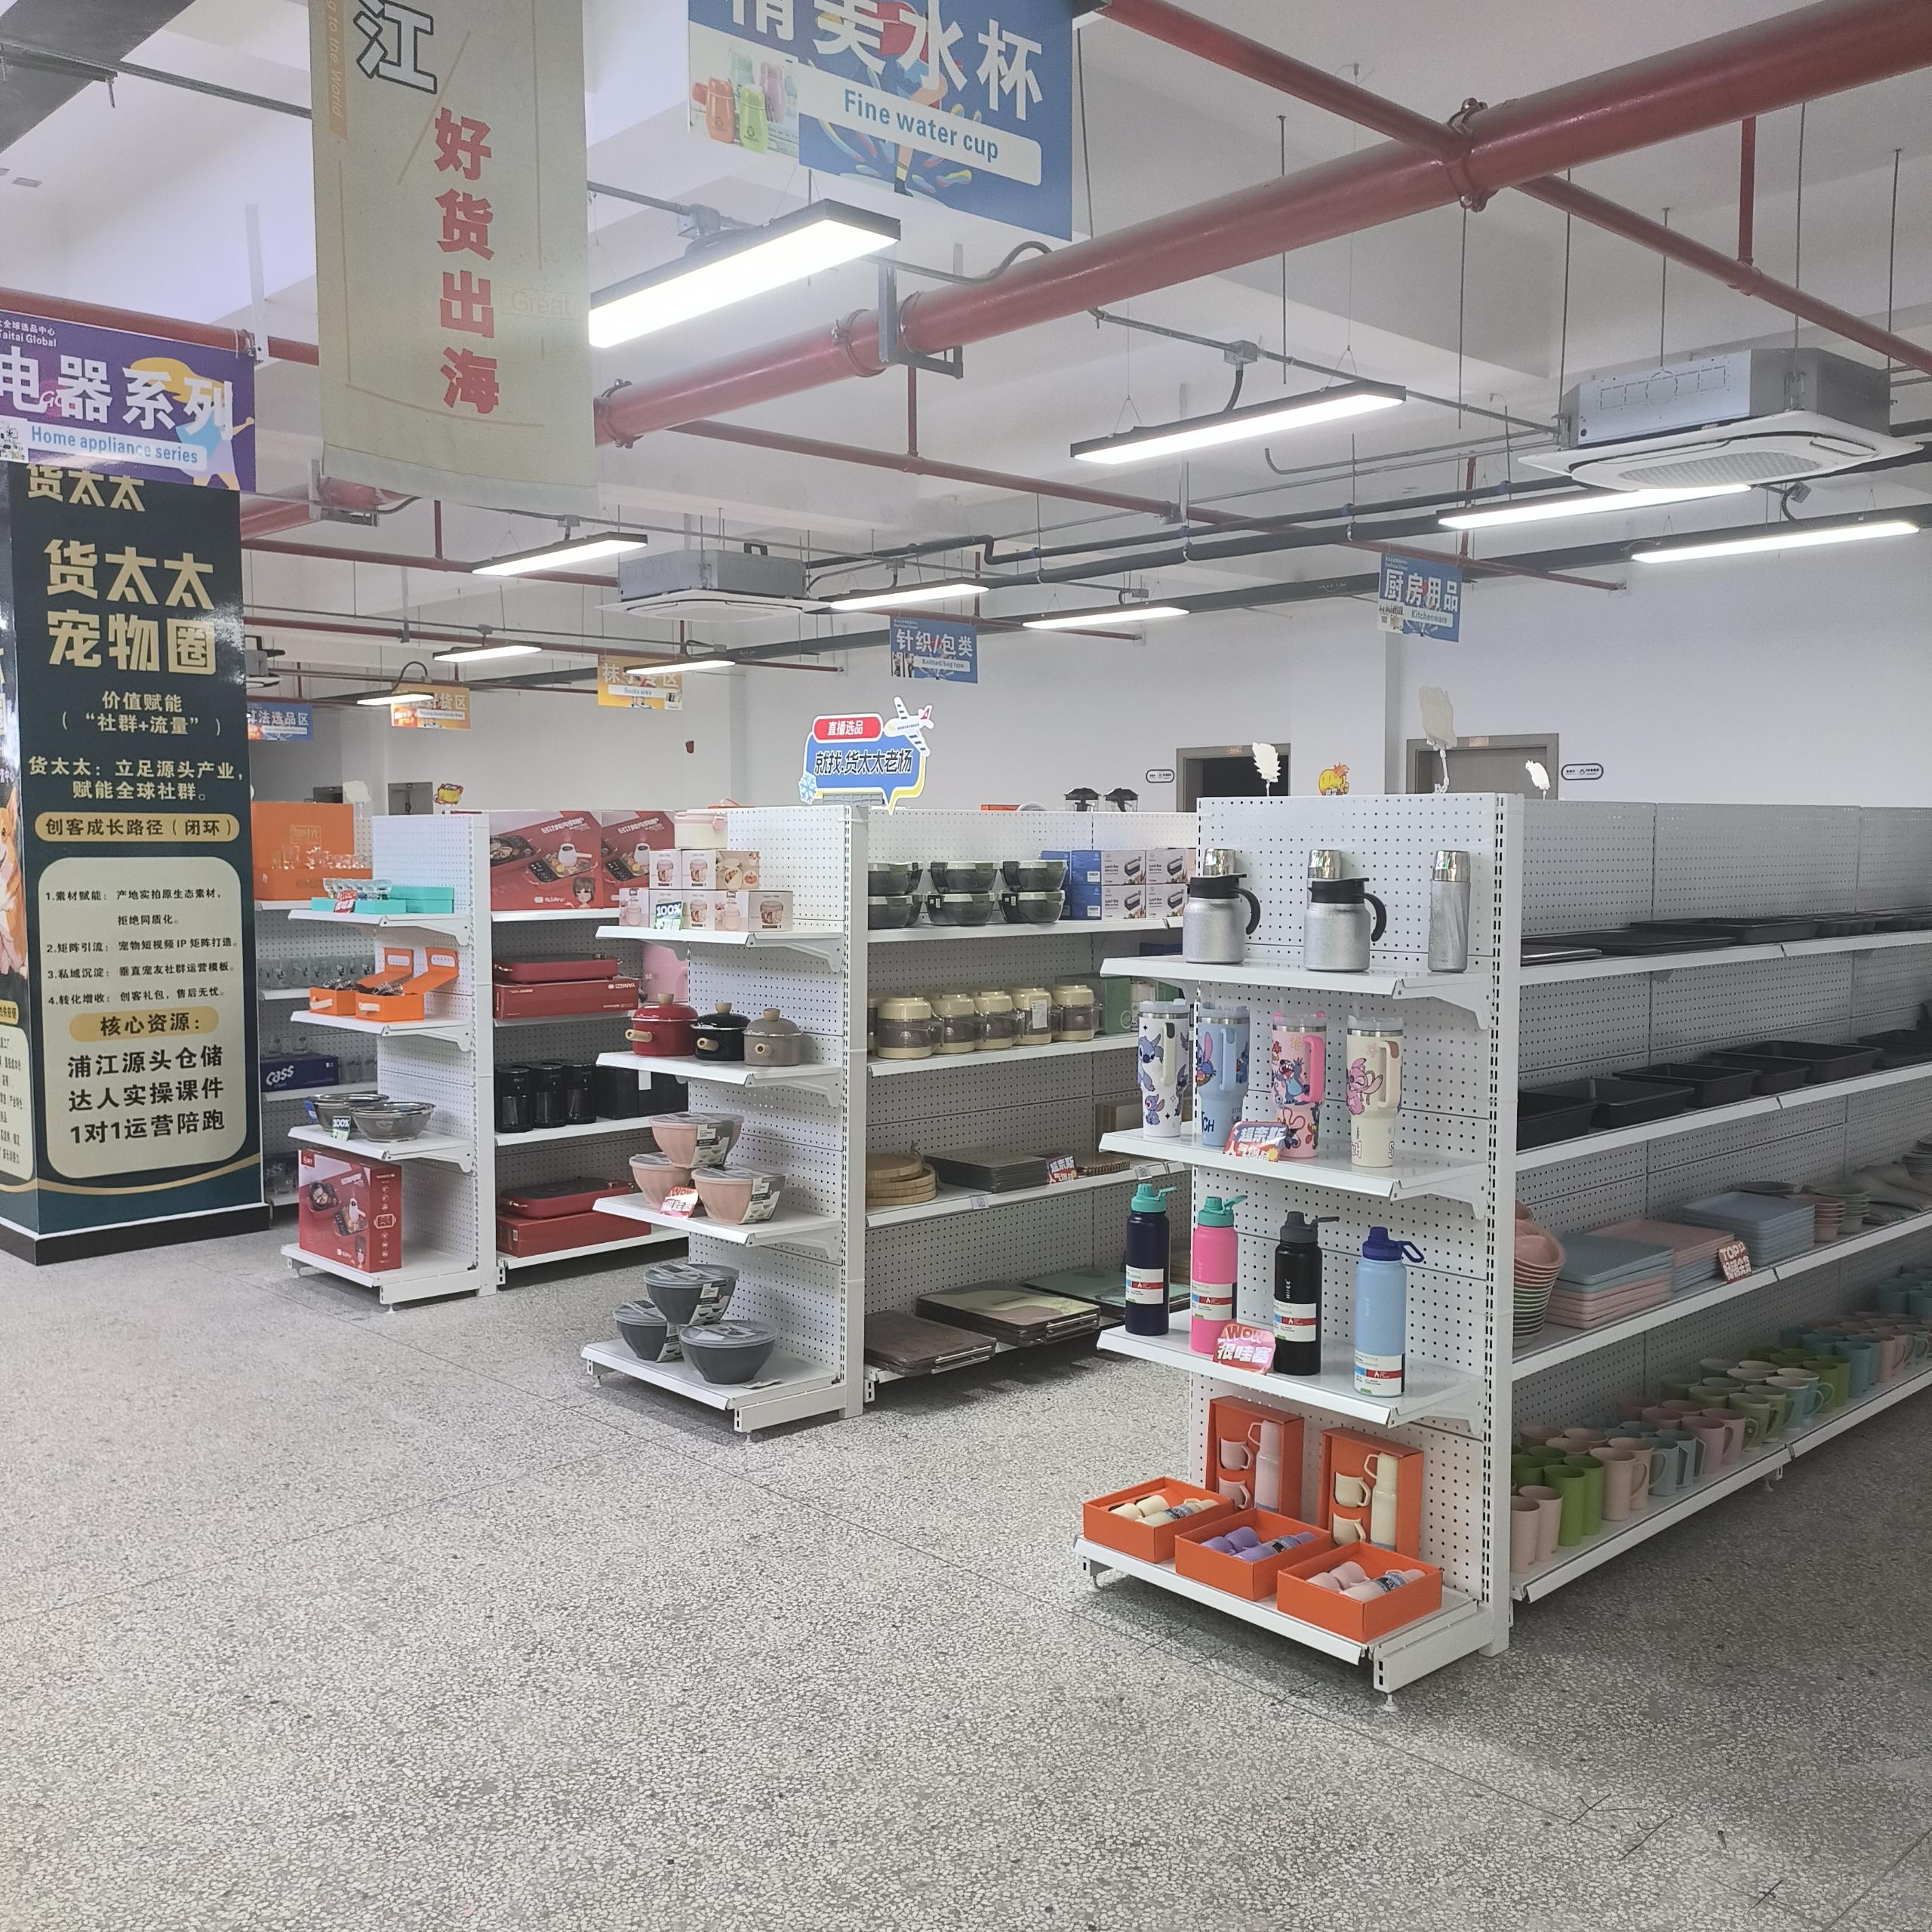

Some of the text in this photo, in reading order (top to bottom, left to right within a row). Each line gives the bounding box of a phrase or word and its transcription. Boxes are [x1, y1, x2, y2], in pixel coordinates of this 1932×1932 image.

[353, 0, 438, 95] 江
[844, 88, 999, 160] Fine water cup
[434, 106, 500, 414] 好货出海
[26, 334, 57, 347] Global
[0, 345, 234, 441] 电器系列
[32, 426, 198, 463] Home appliance series
[26, 463, 146, 512] 货太太
[43, 538, 215, 611] 货太太
[1384, 568, 1459, 612] 厨房用品
[47, 608, 217, 675] 宠物圈
[896, 628, 974, 658] 针织/包类
[101, 690, 183, 713] 价值赋能
[827, 720, 864, 737] 直播选品
[72, 780, 206, 801] 赋能全球社群。
[118, 914, 180, 926] 拒绝同质化。
[657, 904, 681, 916] 100%
[68, 1044, 224, 1078] 浦江源头仓储
[69, 1076, 225, 1112] 达人实操课件
[71, 1109, 226, 1144] 1对1运营陪跑
